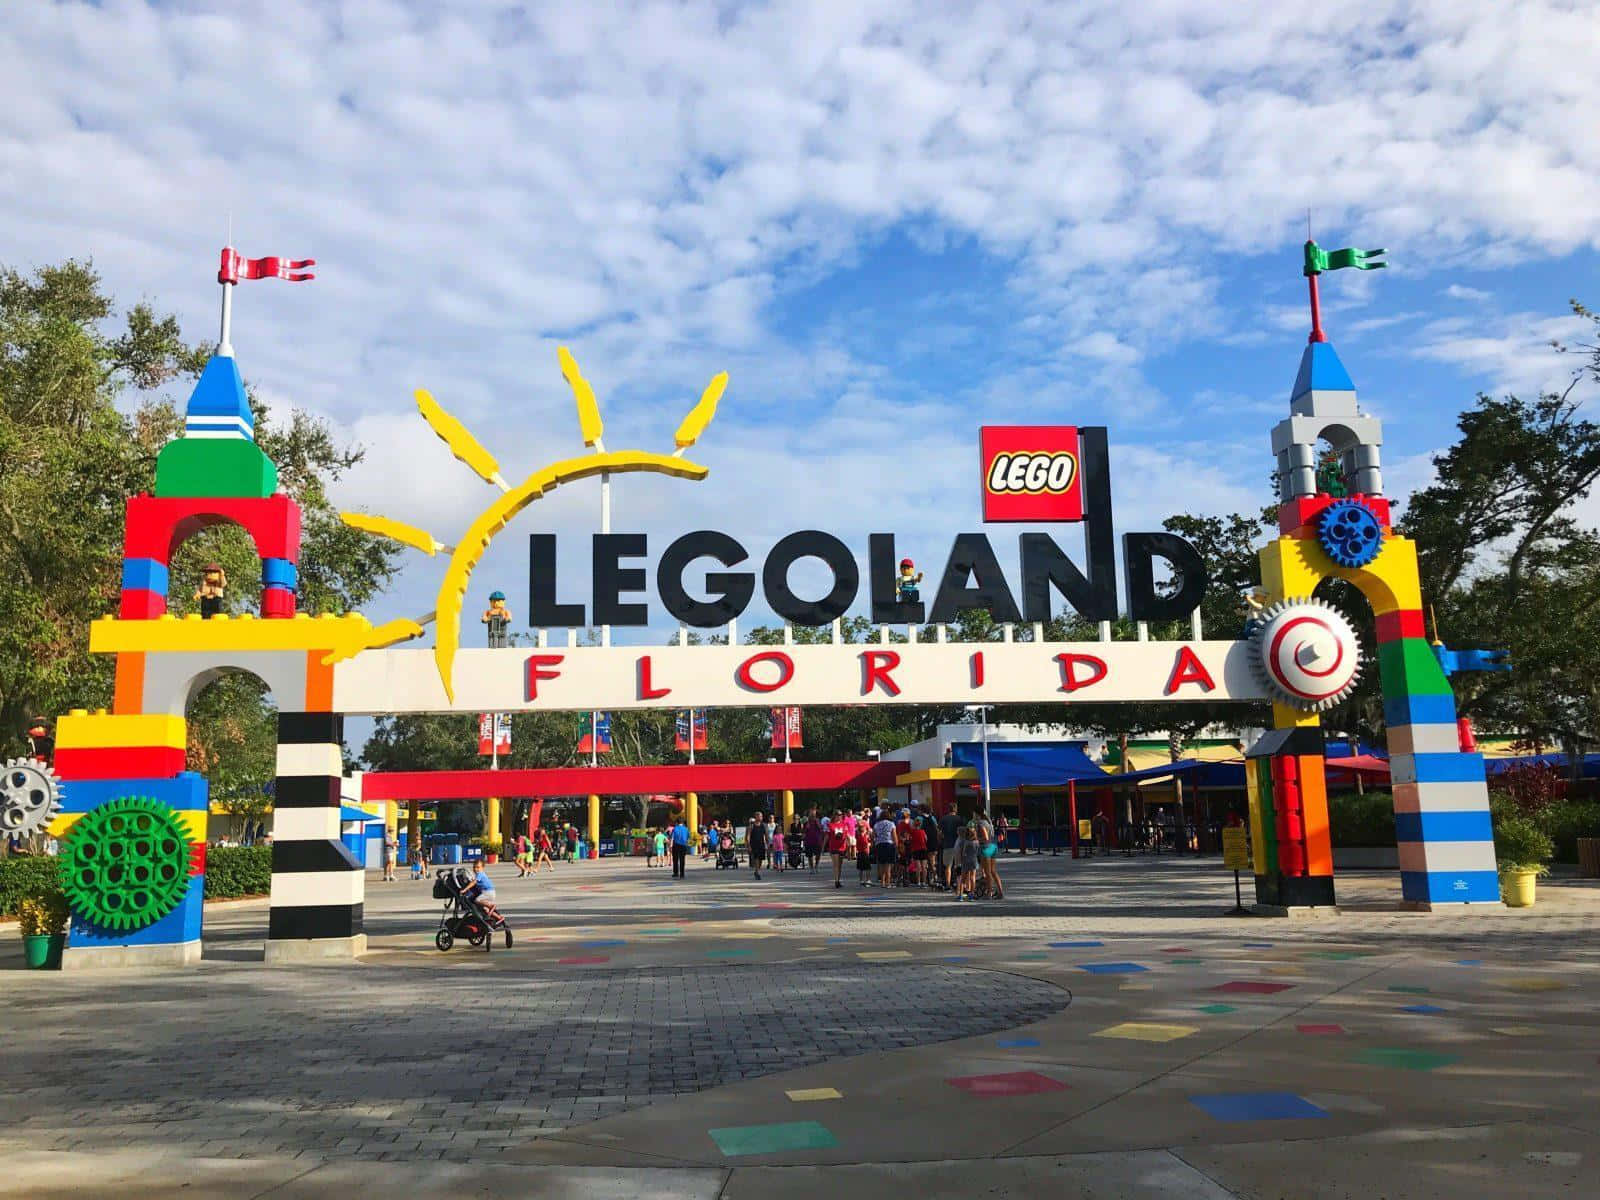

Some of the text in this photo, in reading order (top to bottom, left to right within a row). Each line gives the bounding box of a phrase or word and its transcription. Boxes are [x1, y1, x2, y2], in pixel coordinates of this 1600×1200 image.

[988, 453, 1076, 493] LEGO
[529, 530, 1206, 627] LEGOLAND
[525, 645, 1216, 700] FLORIDA
